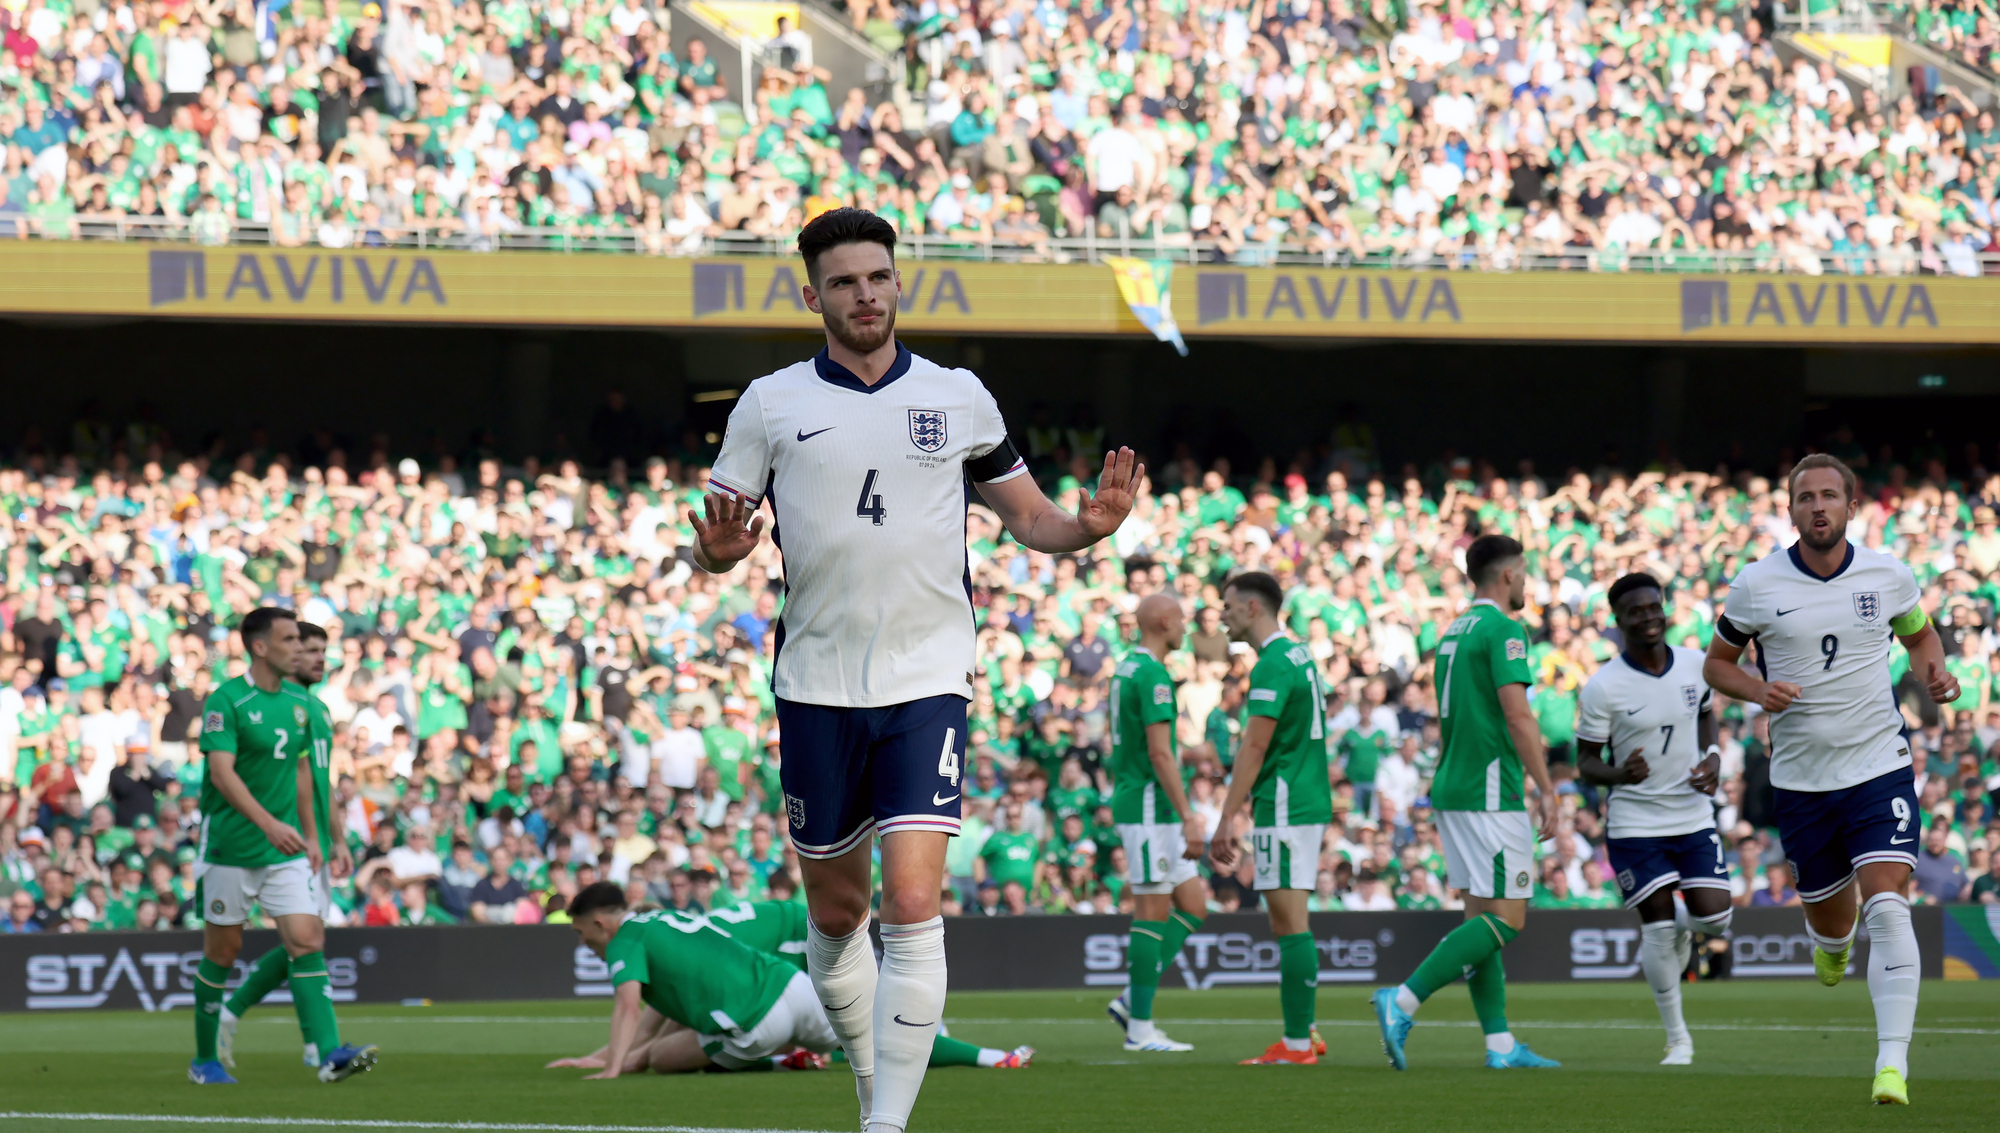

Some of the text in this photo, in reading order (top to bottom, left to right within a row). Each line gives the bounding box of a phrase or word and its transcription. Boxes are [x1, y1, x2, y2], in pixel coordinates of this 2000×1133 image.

[225, 253, 447, 305] AVIVA
[762, 266, 971, 314] AVA
[1263, 276, 1463, 322] AVIVA
[1745, 281, 1939, 327] AVIVA
[857, 469, 887, 526] 4
[1821, 634, 1839, 672] 9
[1438, 641, 1458, 718] 7
[273, 727, 289, 760] 2
[313, 738, 329, 769] 11
[938, 727, 960, 787] 4
[1661, 725, 1674, 755] 7
[1890, 796, 1911, 832] 9
[26, 947, 358, 1012] STATSs
[1084, 932, 1377, 990] STSpts
